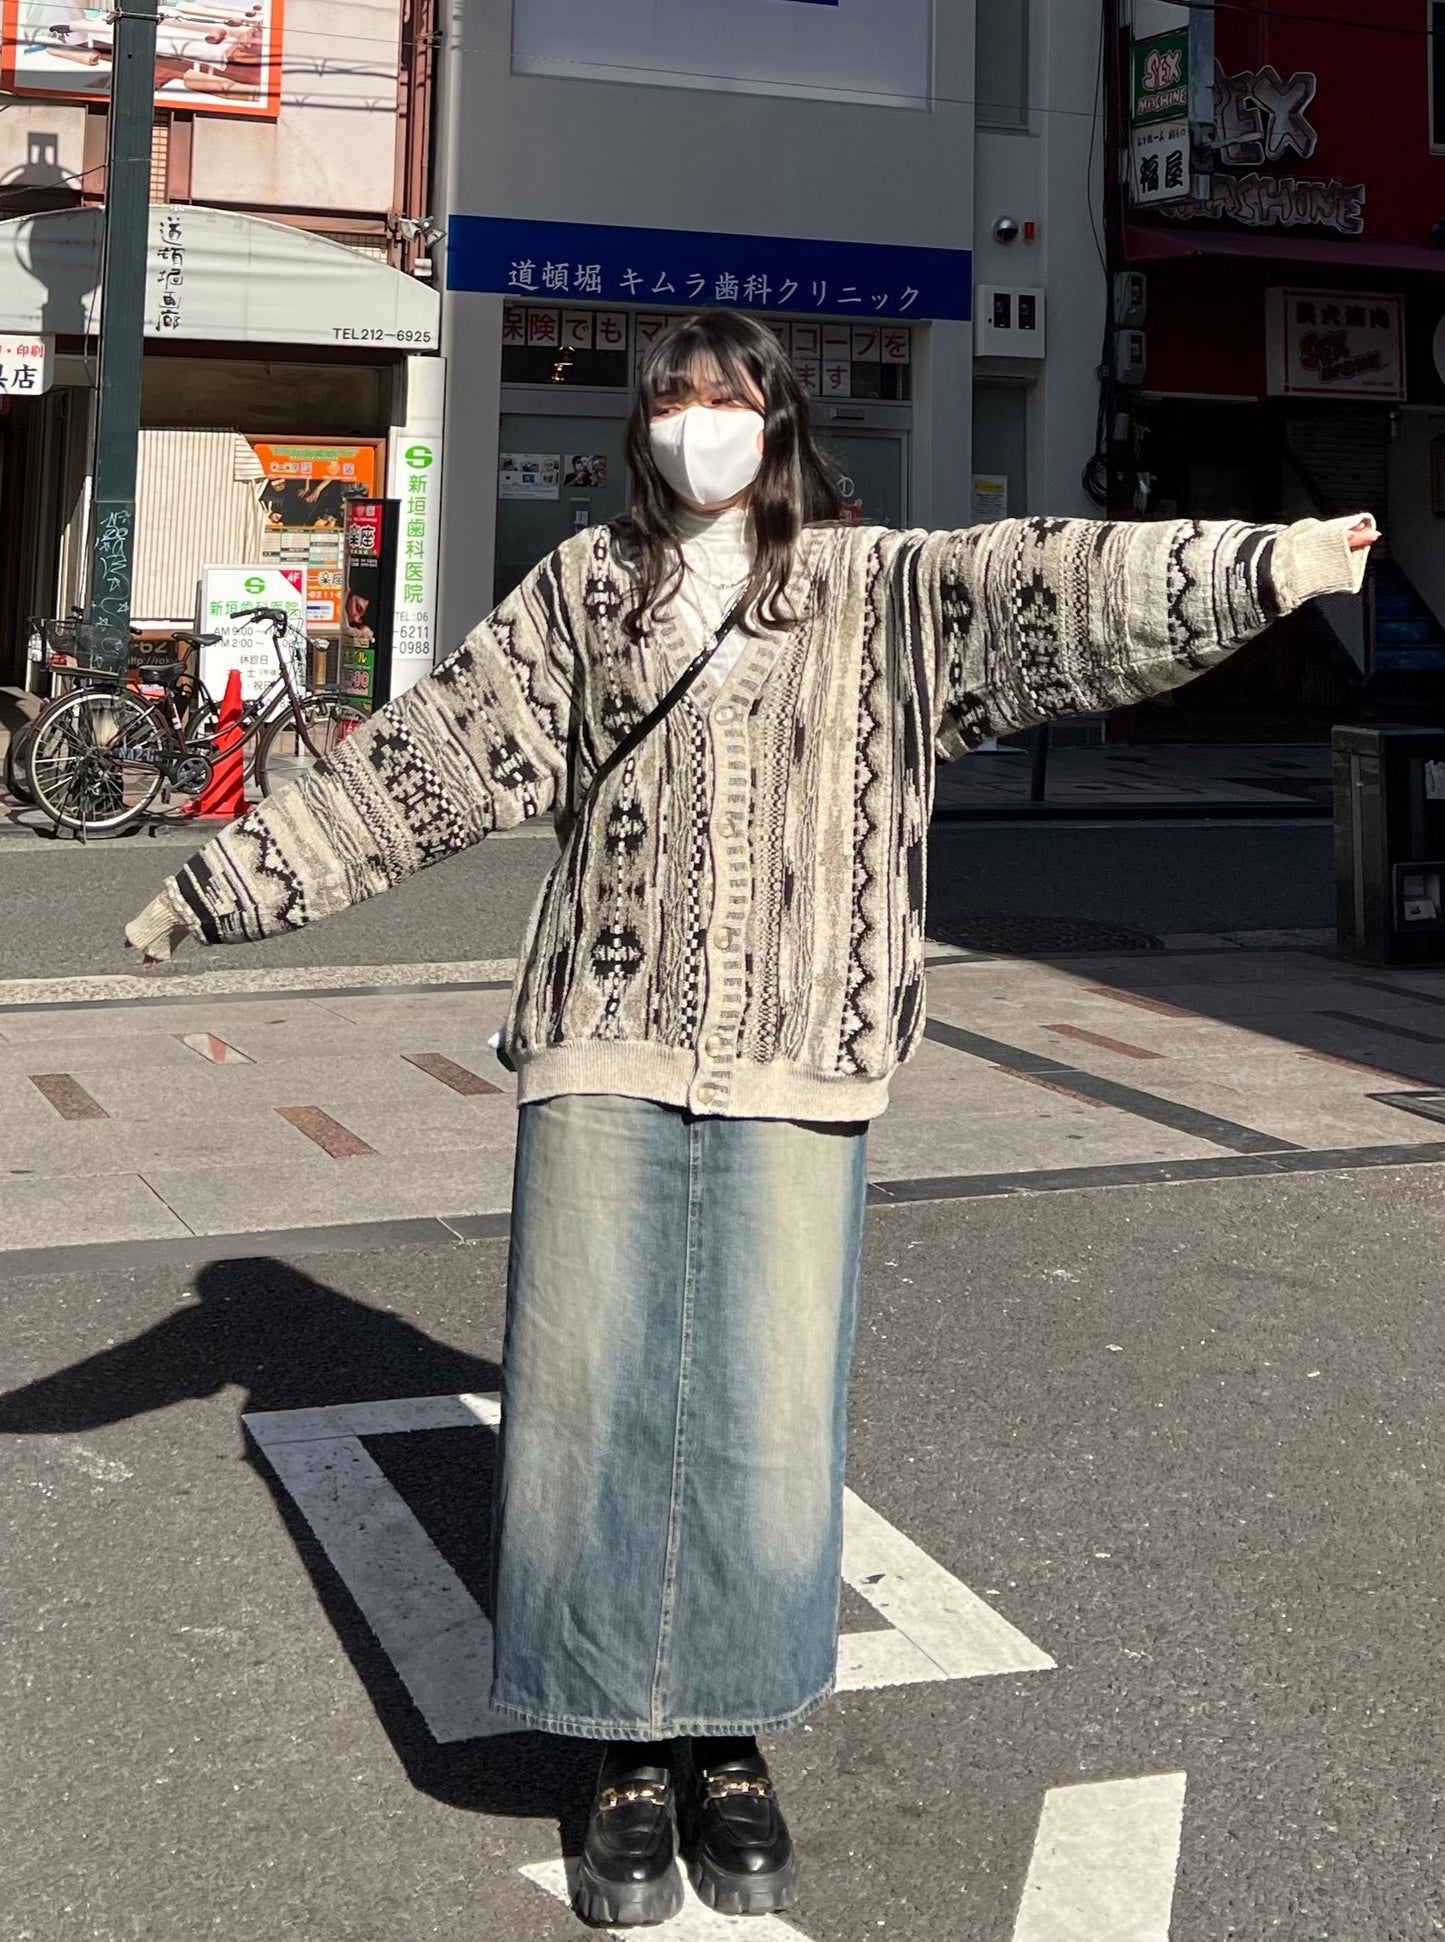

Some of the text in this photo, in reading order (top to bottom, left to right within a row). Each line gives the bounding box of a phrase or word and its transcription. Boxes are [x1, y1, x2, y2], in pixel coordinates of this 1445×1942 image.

[1143, 50, 1182, 91] SEX
[1213, 57, 1317, 165] EX
[508, 260, 921, 312] 道頓堀 キムラ歯科クリニック
[403, 474, 428, 604] 新垣歯科医院
[286, 572, 300, 582] 4F
[240, 655, 268, 665] 休診日
